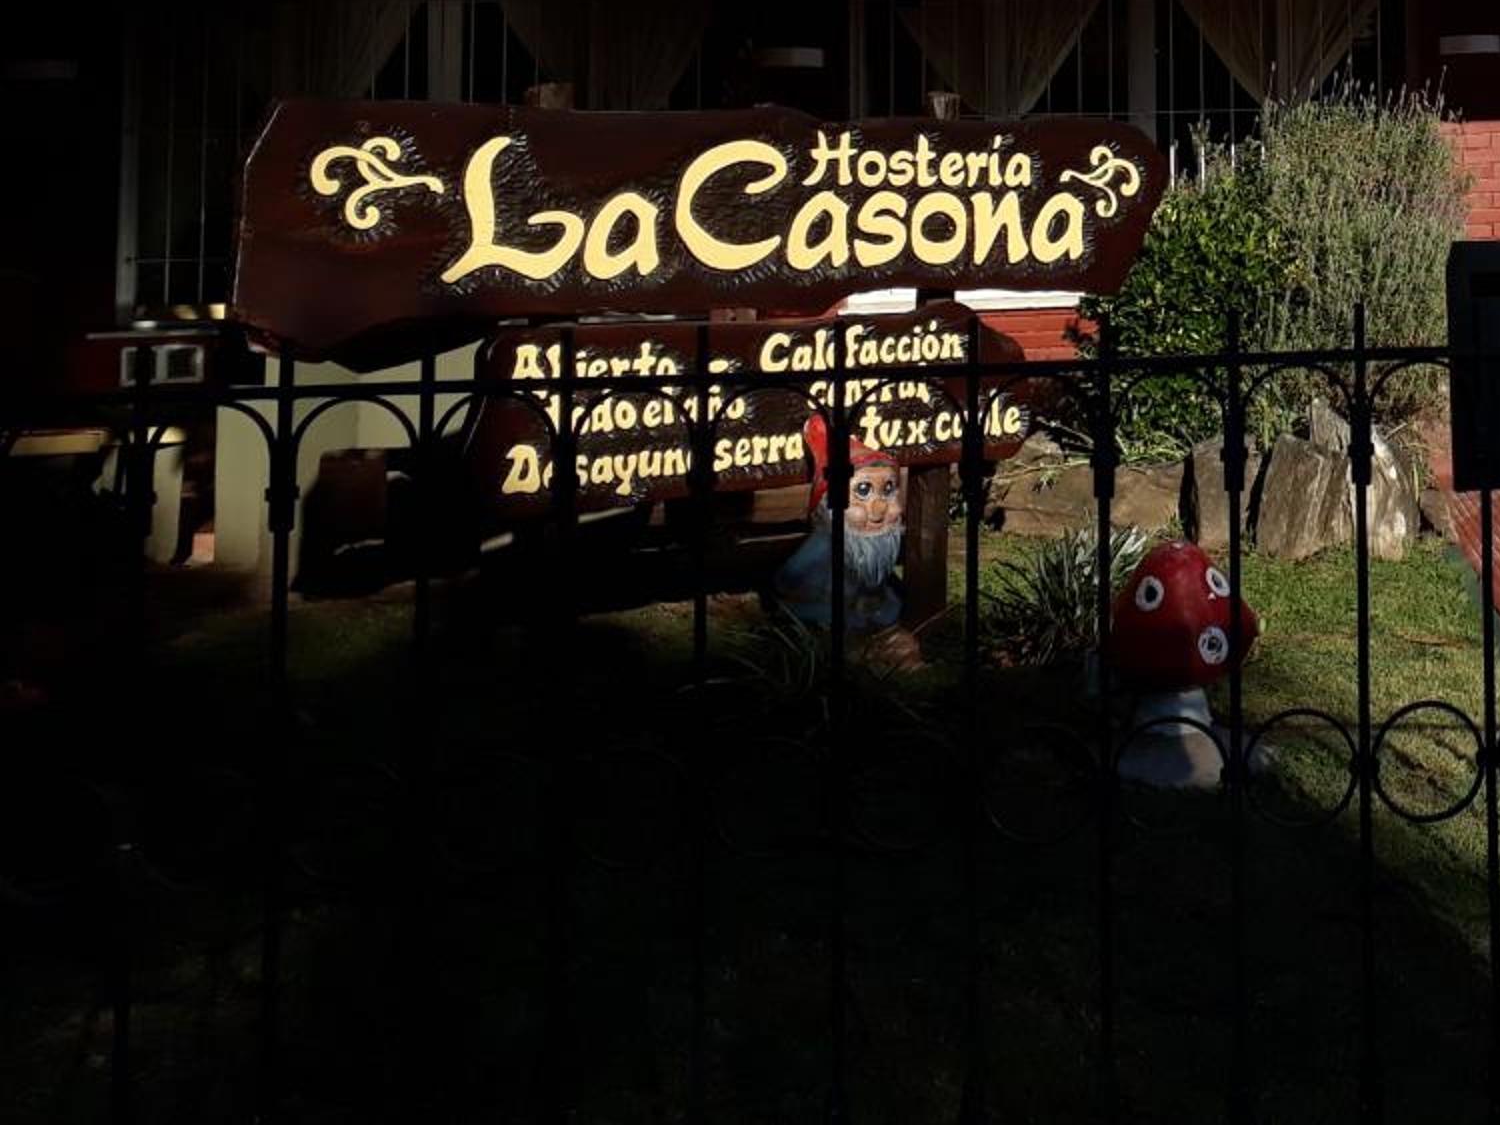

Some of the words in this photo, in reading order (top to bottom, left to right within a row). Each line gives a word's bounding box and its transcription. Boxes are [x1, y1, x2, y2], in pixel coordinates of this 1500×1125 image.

[440, 136, 660, 283] La
[675, 139, 1085, 271] Casona
[802, 130, 1031, 187] Hostería
